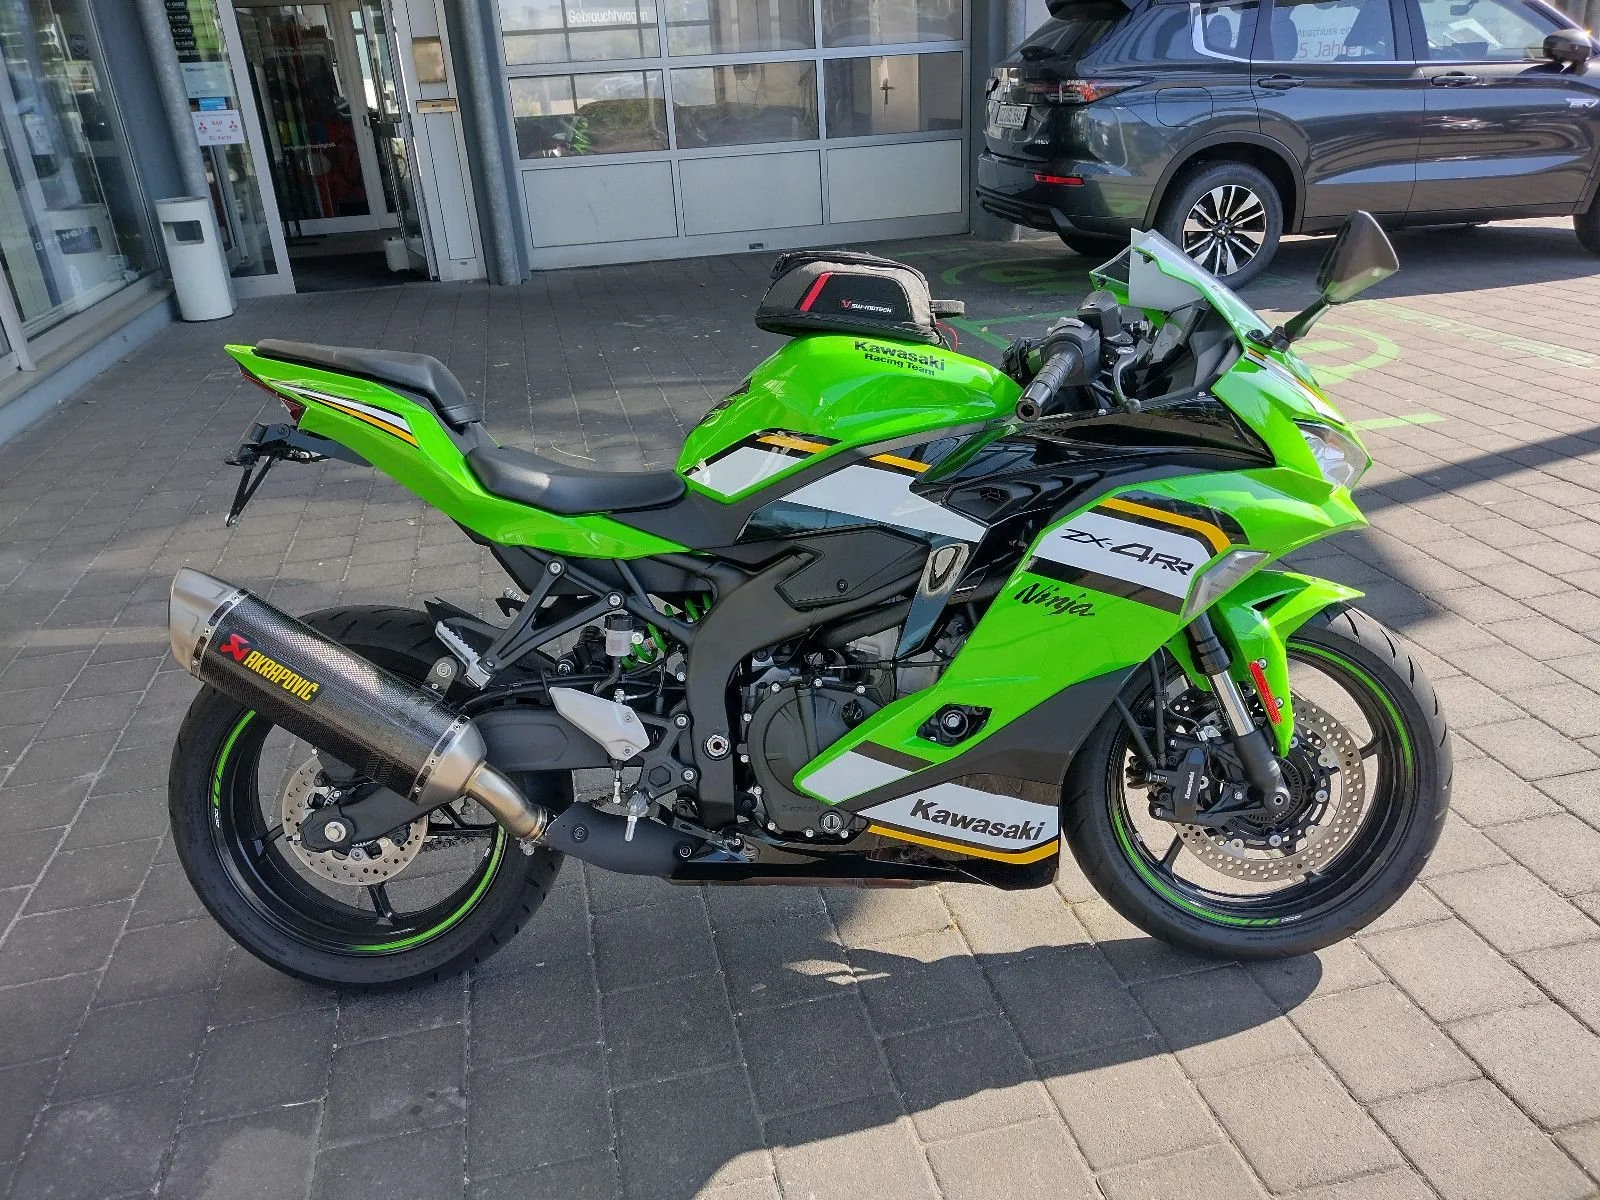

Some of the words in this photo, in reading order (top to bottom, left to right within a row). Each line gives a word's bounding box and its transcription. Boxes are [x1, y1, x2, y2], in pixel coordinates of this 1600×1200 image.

[854, 340, 945, 371] Kawasaki
[864, 353, 904, 368] Racing
[905, 361, 935, 376] Team
[1013, 582, 1096, 617] Ninja
[909, 798, 1046, 841] Kawasaki
